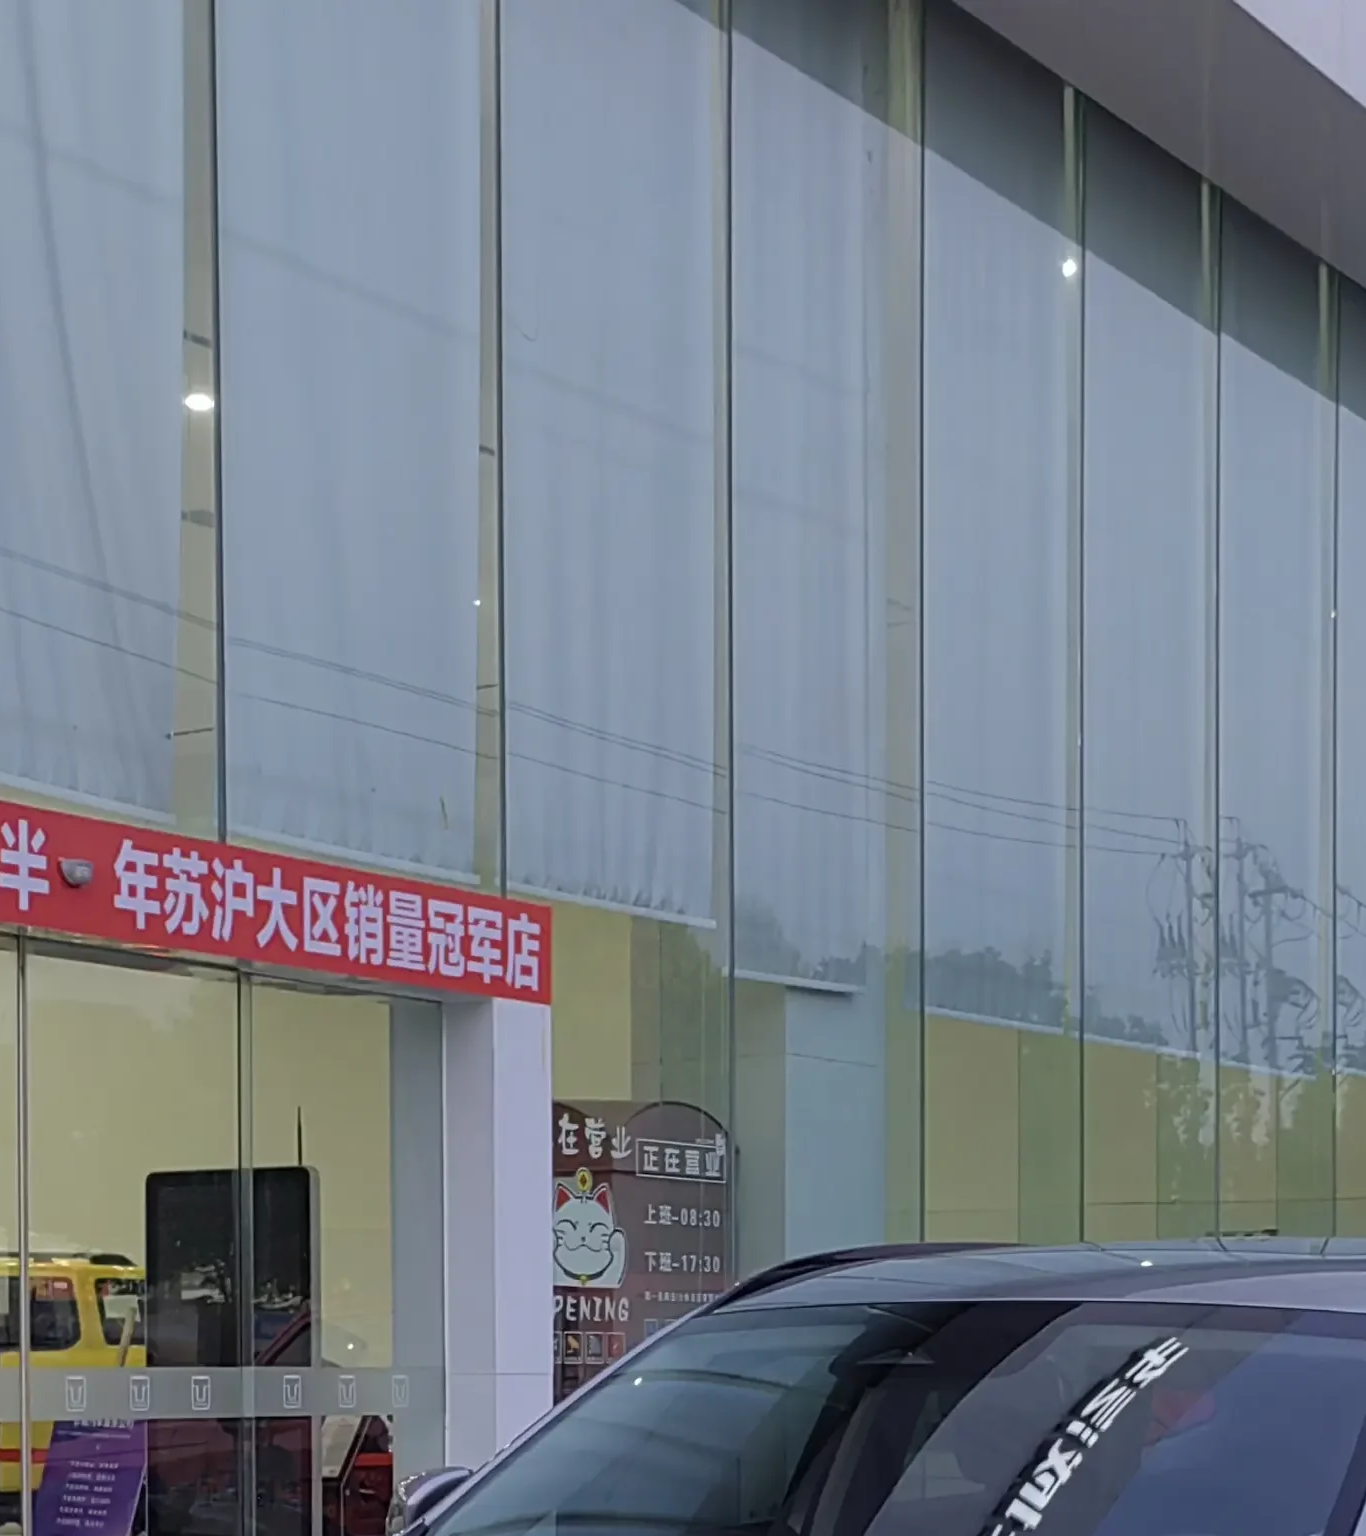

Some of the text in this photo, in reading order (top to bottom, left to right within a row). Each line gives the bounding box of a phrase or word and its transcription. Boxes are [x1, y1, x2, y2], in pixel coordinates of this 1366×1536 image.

[114, 839, 541, 992] 年苏沪大区销量冠军店
[643, 1146, 721, 1177] 正在营业
